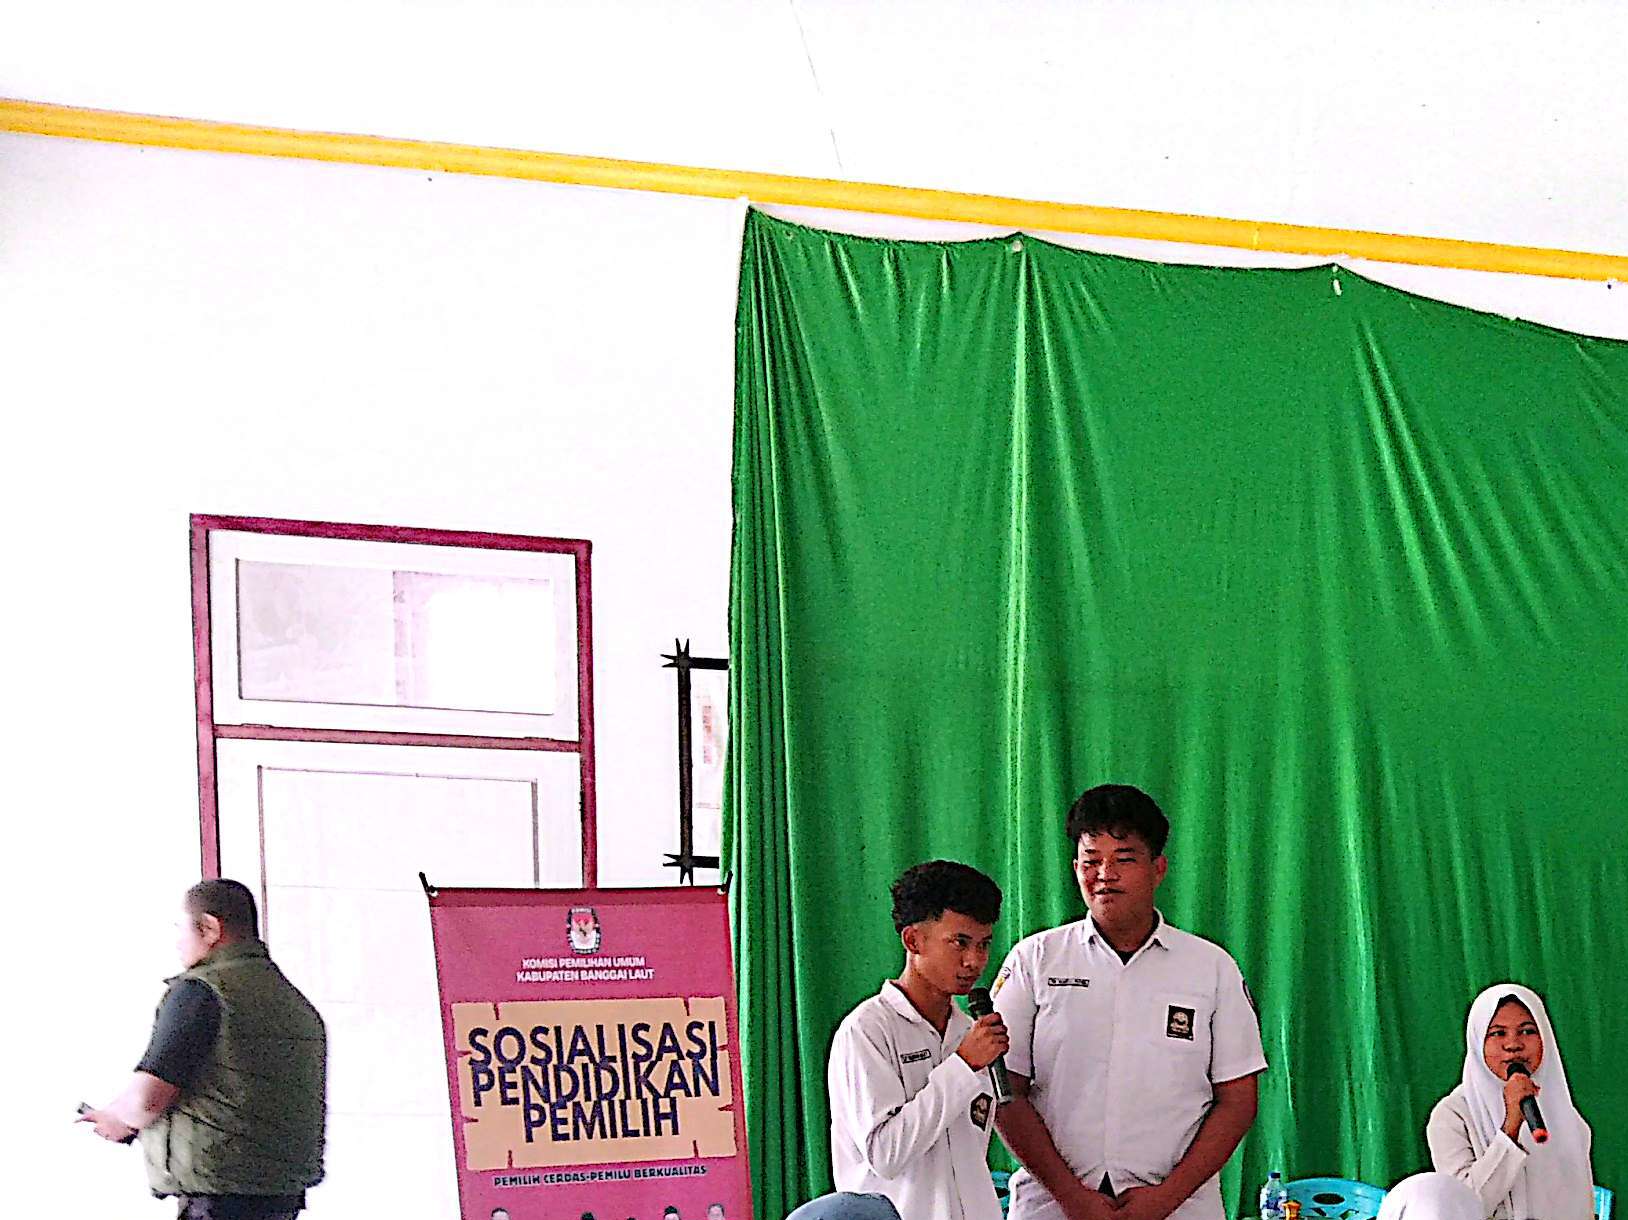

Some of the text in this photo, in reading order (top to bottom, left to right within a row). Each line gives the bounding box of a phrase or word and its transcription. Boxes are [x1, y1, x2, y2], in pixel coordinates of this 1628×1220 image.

[516, 968, 655, 982] KABUPATEN BANGGAI LAUT
[522, 956, 645, 969] KOMISI PEMILIHAN UMUM
[468, 1020, 718, 1068] SOSIALISASI
[471, 1056, 720, 1107] PENDIDIKAN
[524, 1096, 680, 1143] PEMILIH
[494, 1175, 541, 1187] PEMILIH
[634, 1165, 707, 1179] BERKUALITAS
